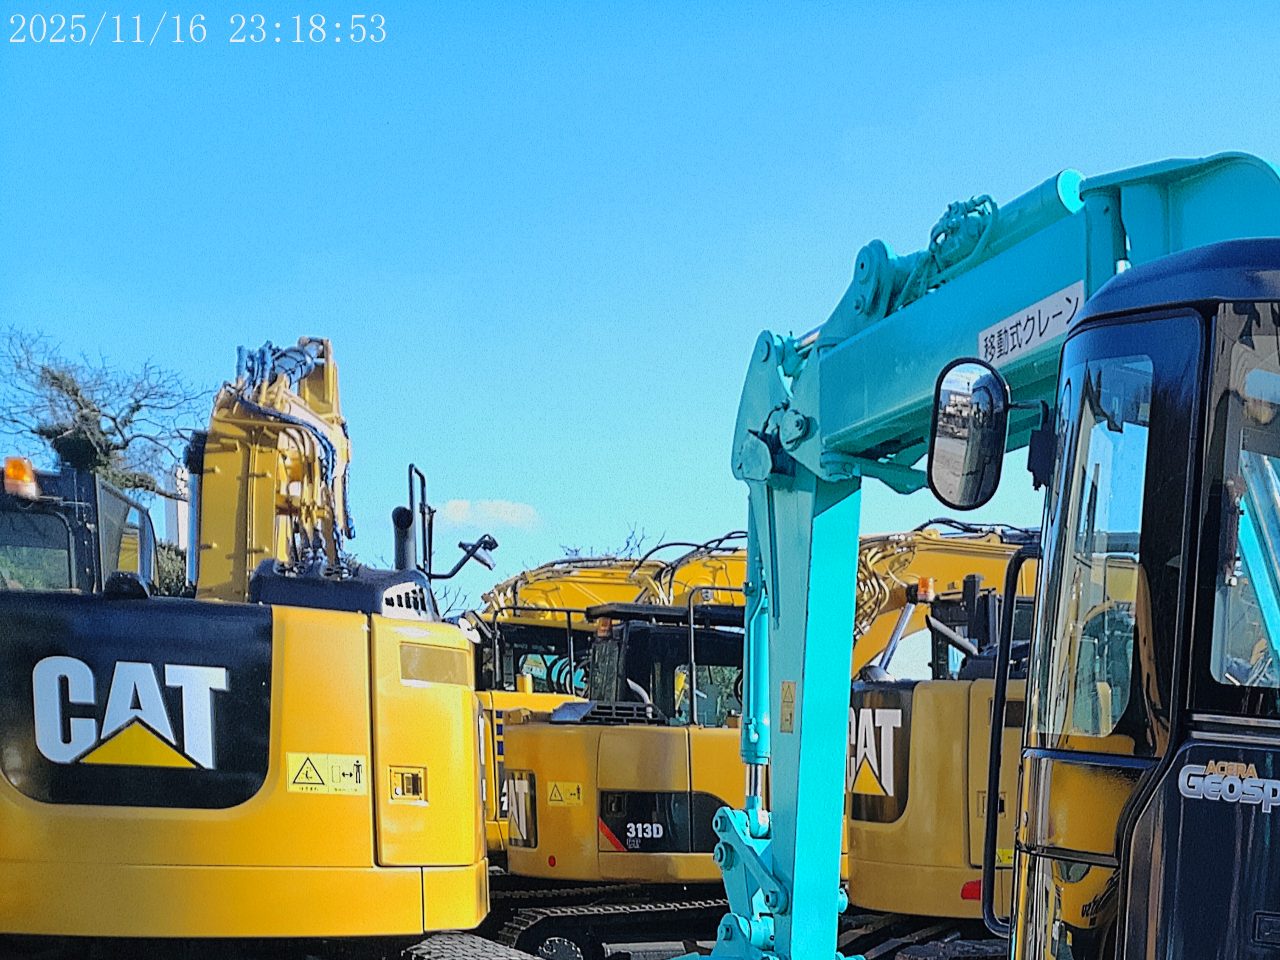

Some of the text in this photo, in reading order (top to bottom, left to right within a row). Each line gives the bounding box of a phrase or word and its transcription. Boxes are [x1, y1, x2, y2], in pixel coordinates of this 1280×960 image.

[984, 297, 1079, 363] 移動式クレーン
[33, 656, 227, 770] CAT
[1205, 760, 1258, 779] ACERA
[626, 822, 664, 838] 313D
